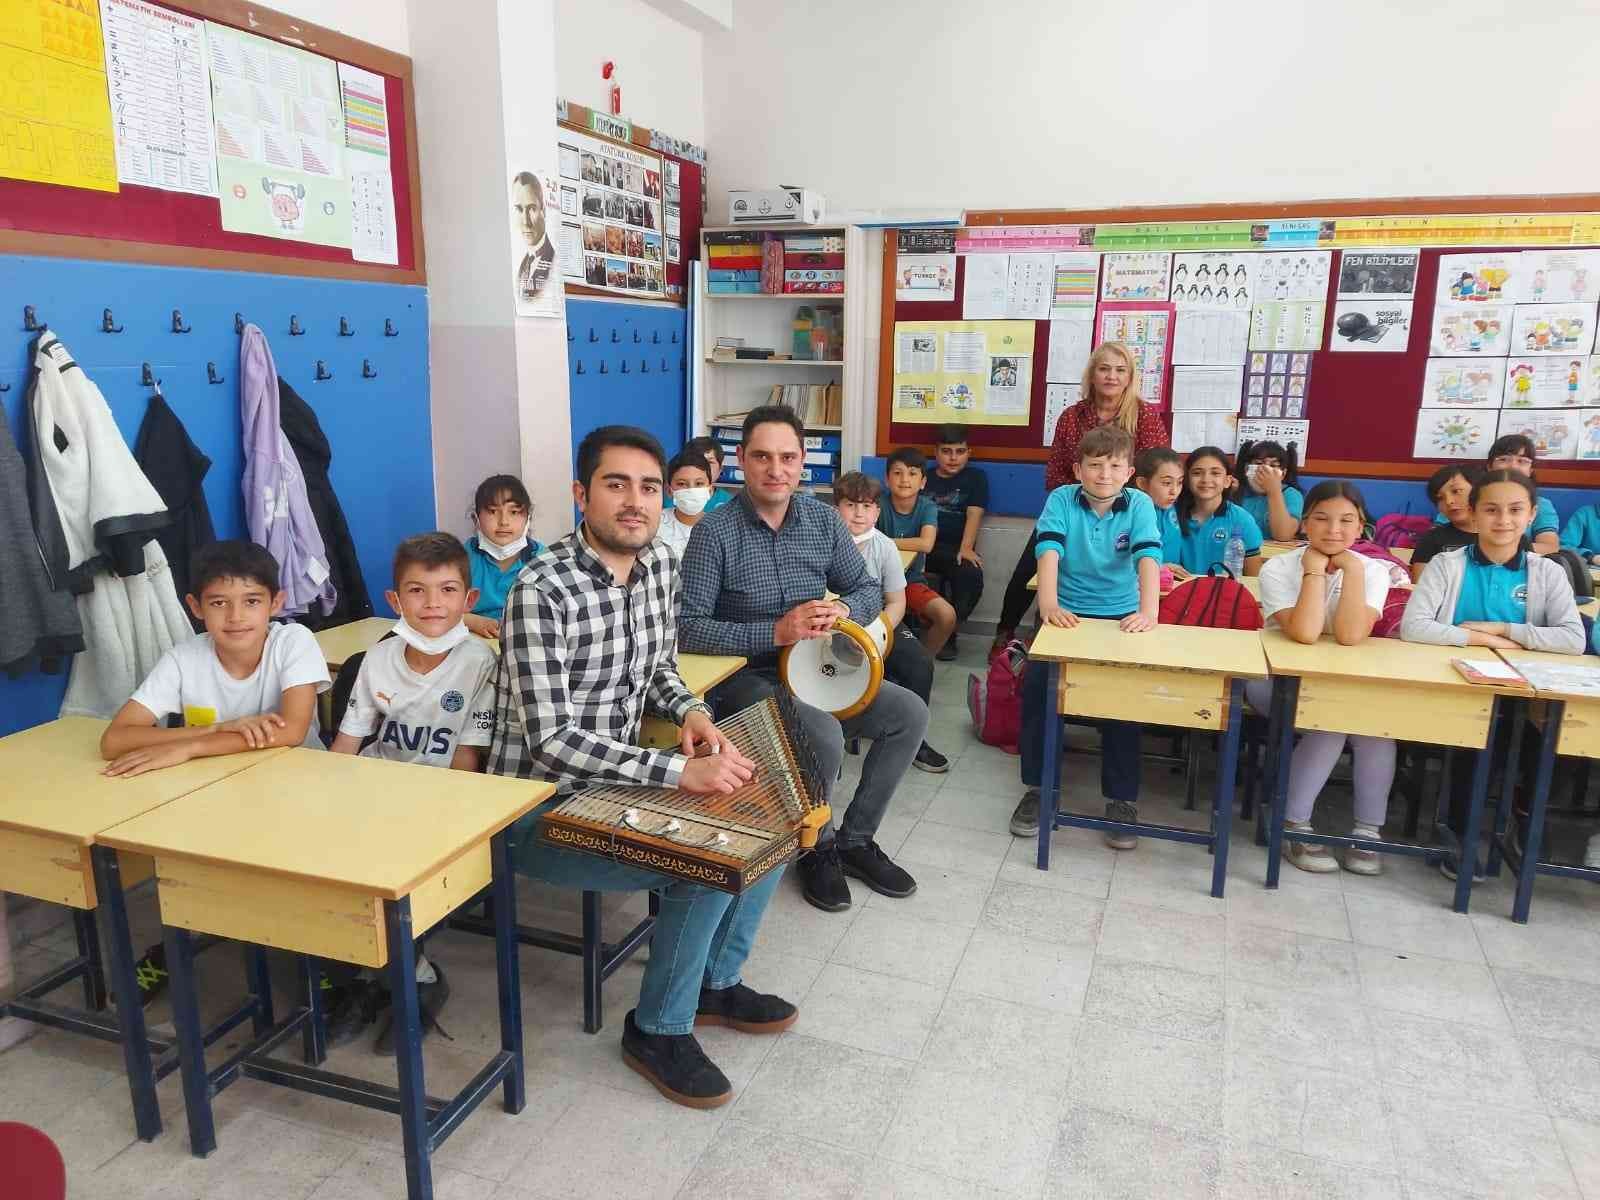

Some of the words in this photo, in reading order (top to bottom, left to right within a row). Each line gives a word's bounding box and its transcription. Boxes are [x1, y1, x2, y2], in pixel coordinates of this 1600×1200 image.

[1345, 256, 1364, 266] FEN
[1365, 253, 1416, 266] BİLİMLERİ
[1375, 309, 1402, 318] sosyal
[1377, 316, 1408, 326] bilgiler
[382, 720, 453, 756] AVIS
